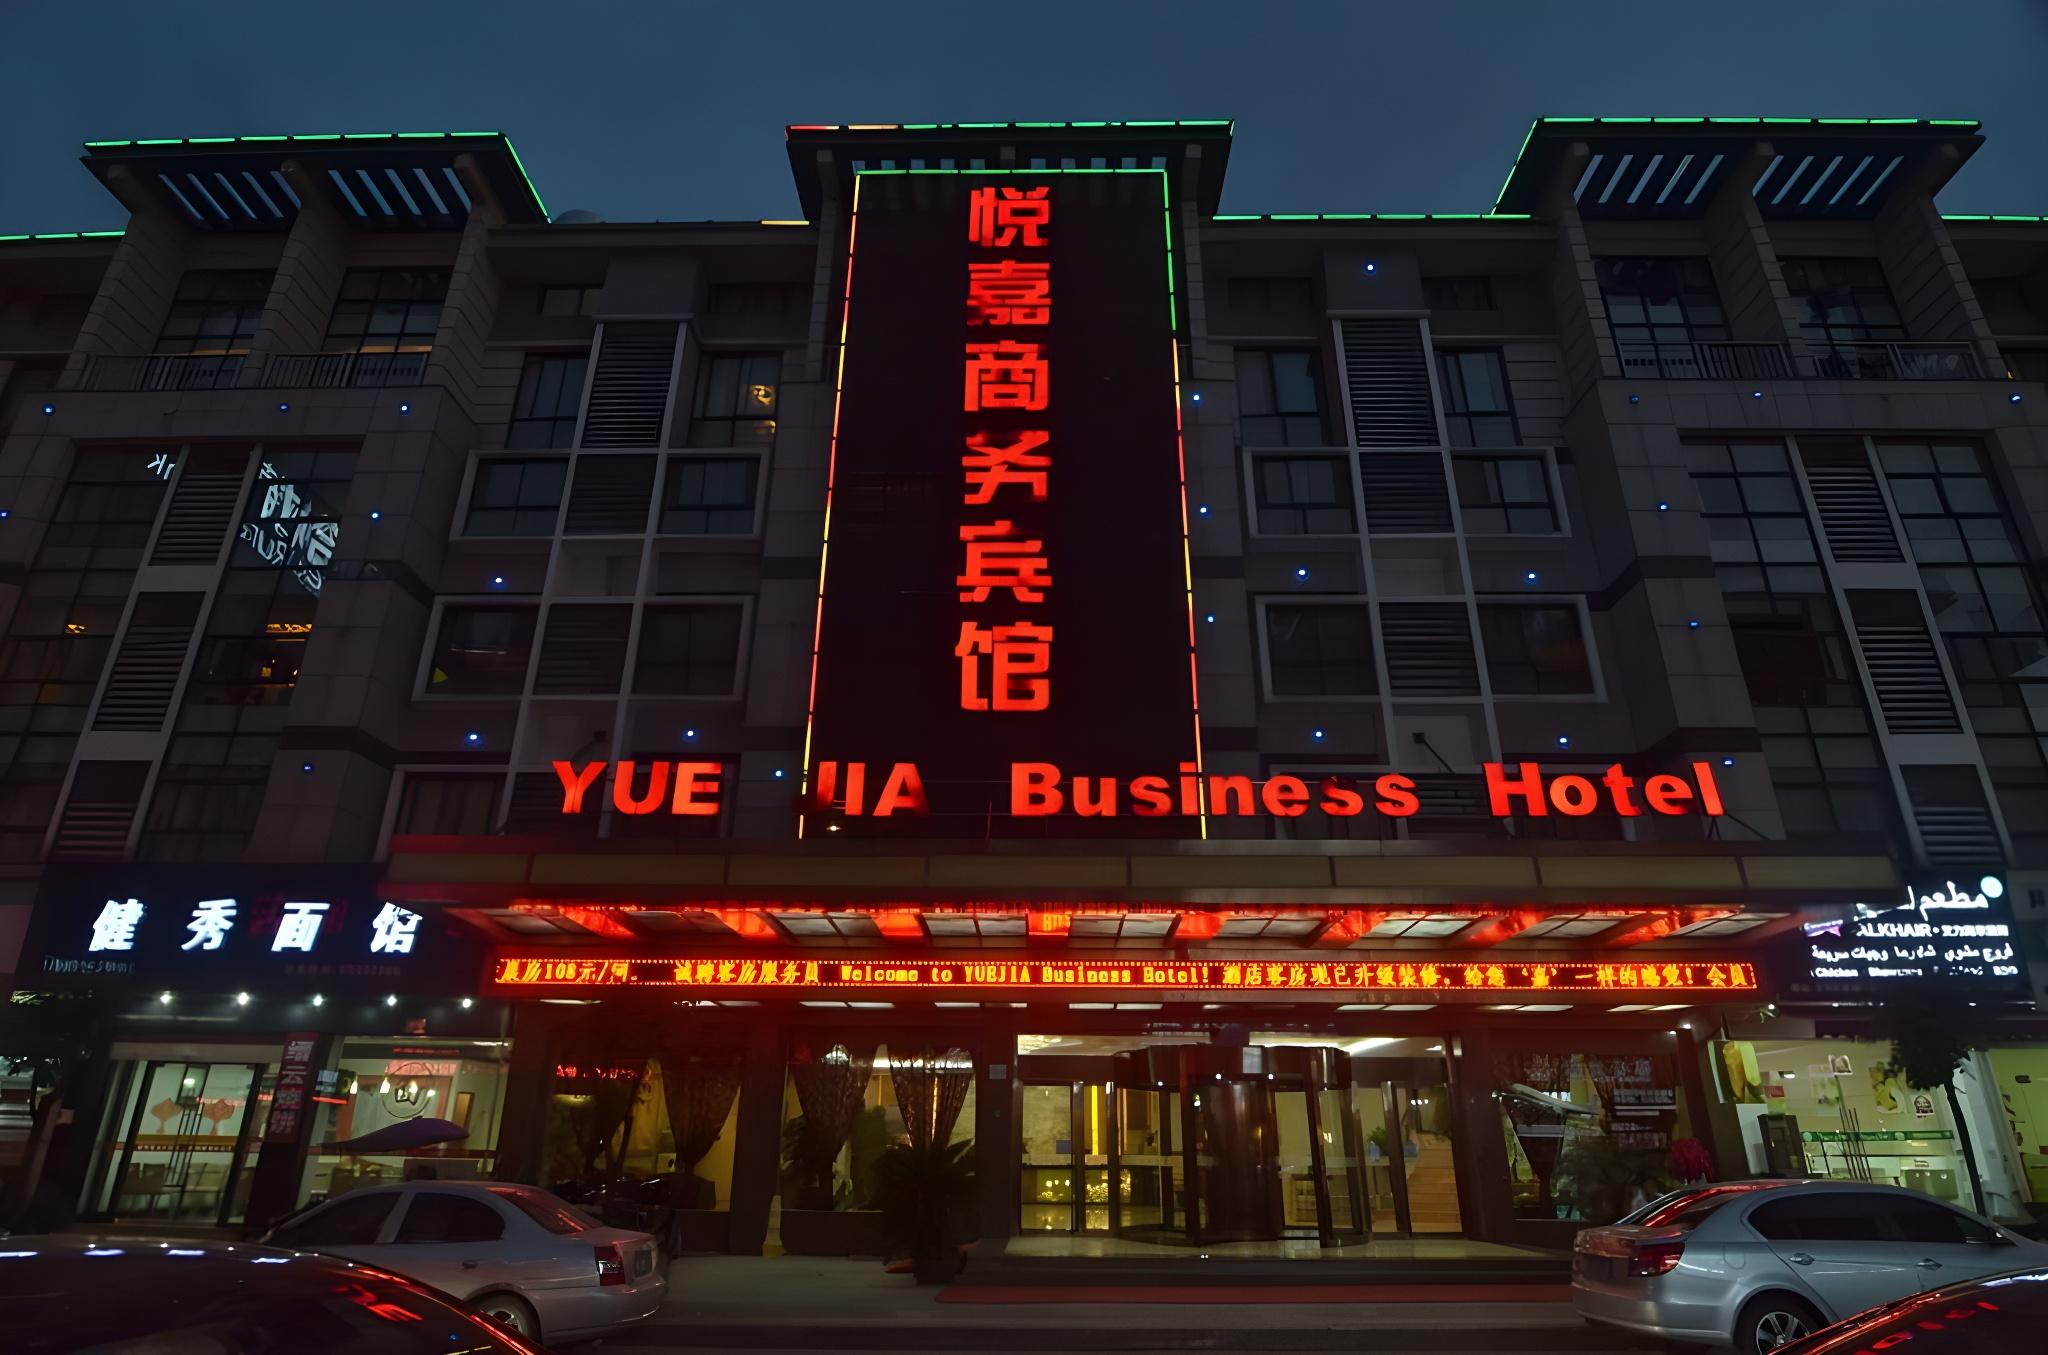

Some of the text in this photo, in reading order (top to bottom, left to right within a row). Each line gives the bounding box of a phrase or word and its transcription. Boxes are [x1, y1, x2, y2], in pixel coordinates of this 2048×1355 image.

[955, 187, 1053, 712] 悦嘉商务宾馆
[552, 761, 722, 815] YUE
[1012, 762, 1419, 816] Business
[1483, 762, 1724, 816] Hotel
[841, 965, 919, 983] Welcome
[931, 967, 953, 983] to
[1042, 965, 1131, 984] Business
